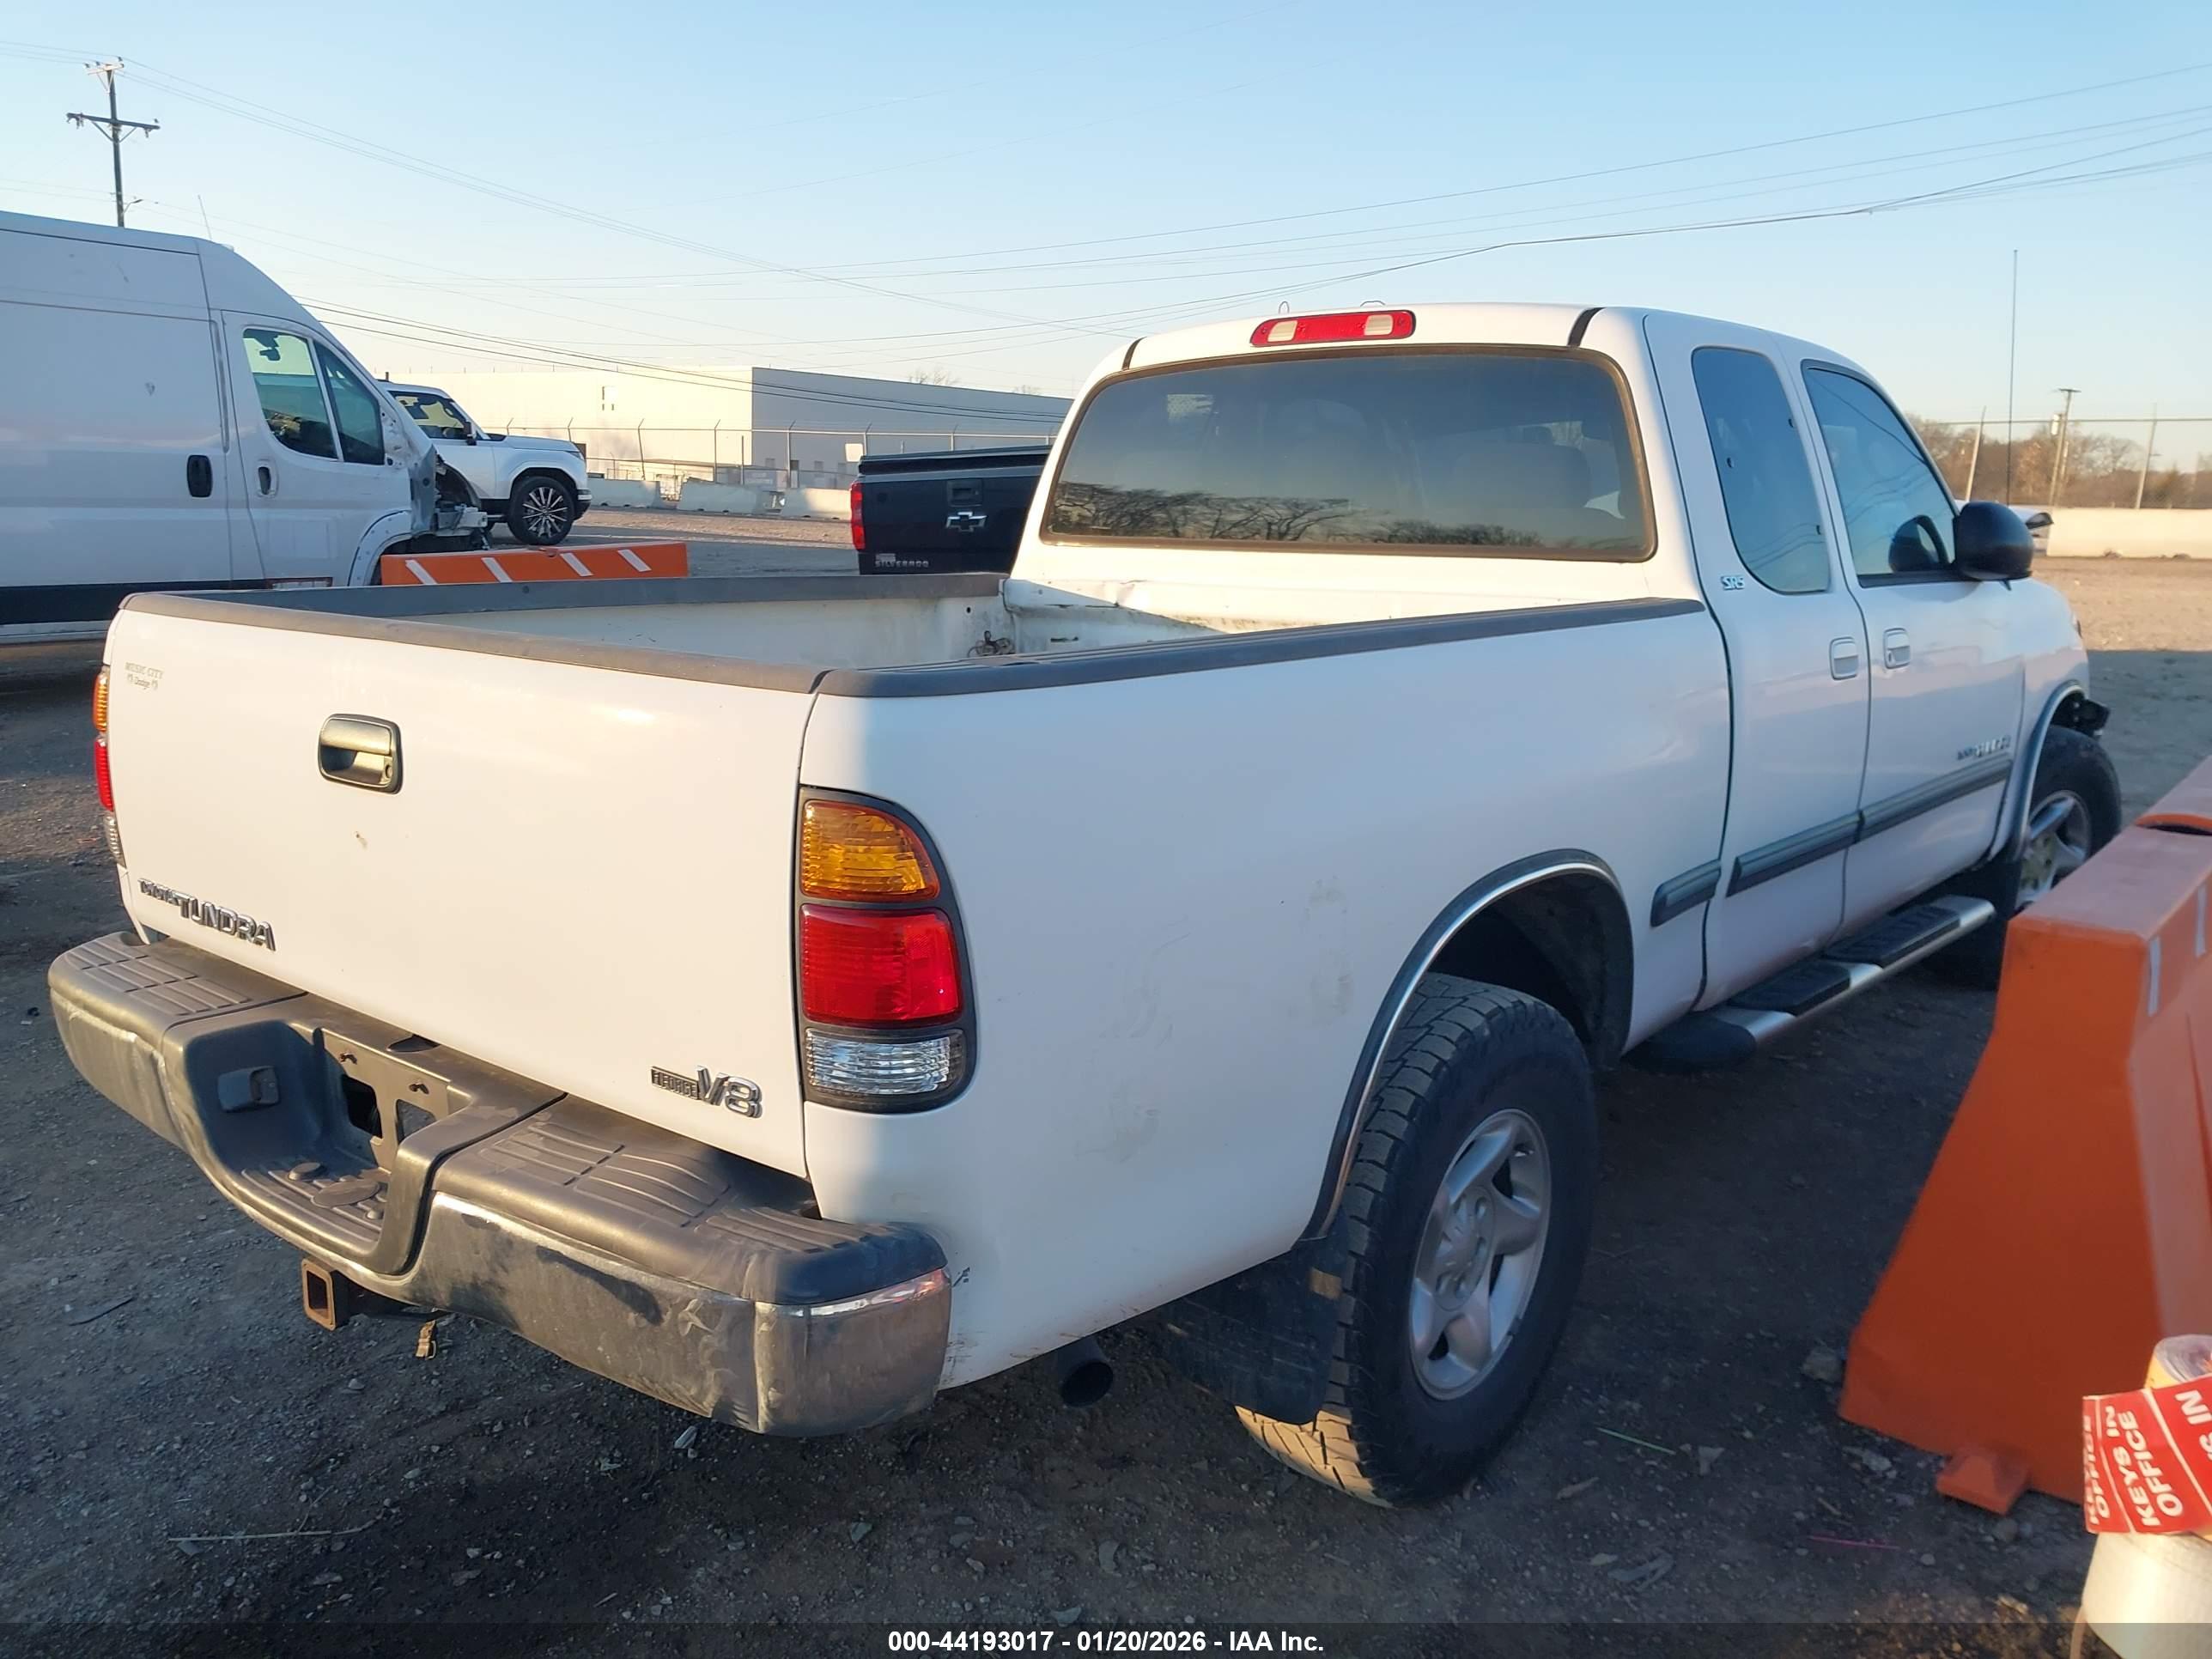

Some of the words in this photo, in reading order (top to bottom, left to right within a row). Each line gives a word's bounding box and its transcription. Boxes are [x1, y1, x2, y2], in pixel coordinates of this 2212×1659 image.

[173, 890, 276, 951] TUNDRA
[695, 1065, 763, 1118] V8
[2105, 1406, 2121, 1438] IN
[2112, 1445, 2162, 1527] KEYS
[2117, 1410, 2184, 1517] OFFICE
